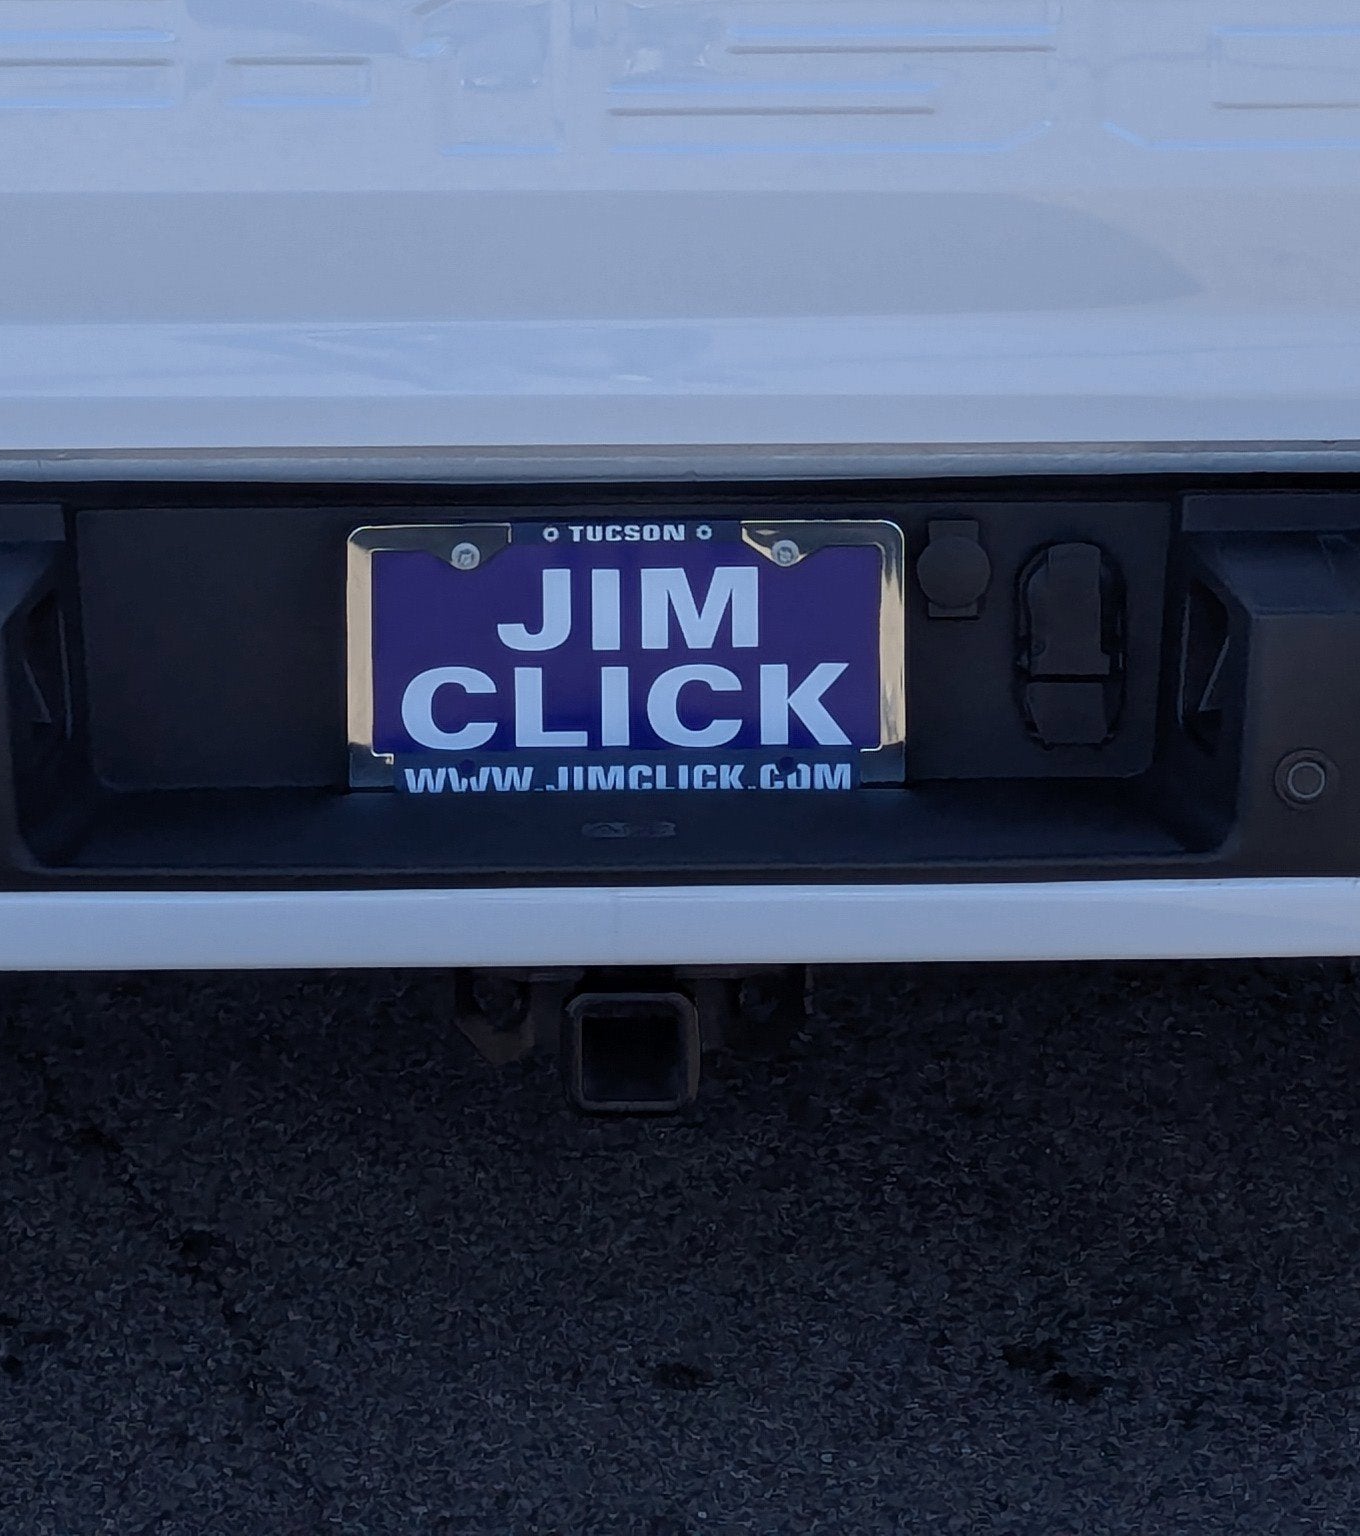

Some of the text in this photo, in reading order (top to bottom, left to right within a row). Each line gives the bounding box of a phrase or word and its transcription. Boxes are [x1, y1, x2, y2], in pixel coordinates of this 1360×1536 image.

[568, 524, 685, 542] TUCSON
[497, 566, 759, 651] JIM
[401, 663, 853, 750] CLICK
[404, 763, 851, 793] WWW.JIMCLICK.COM
